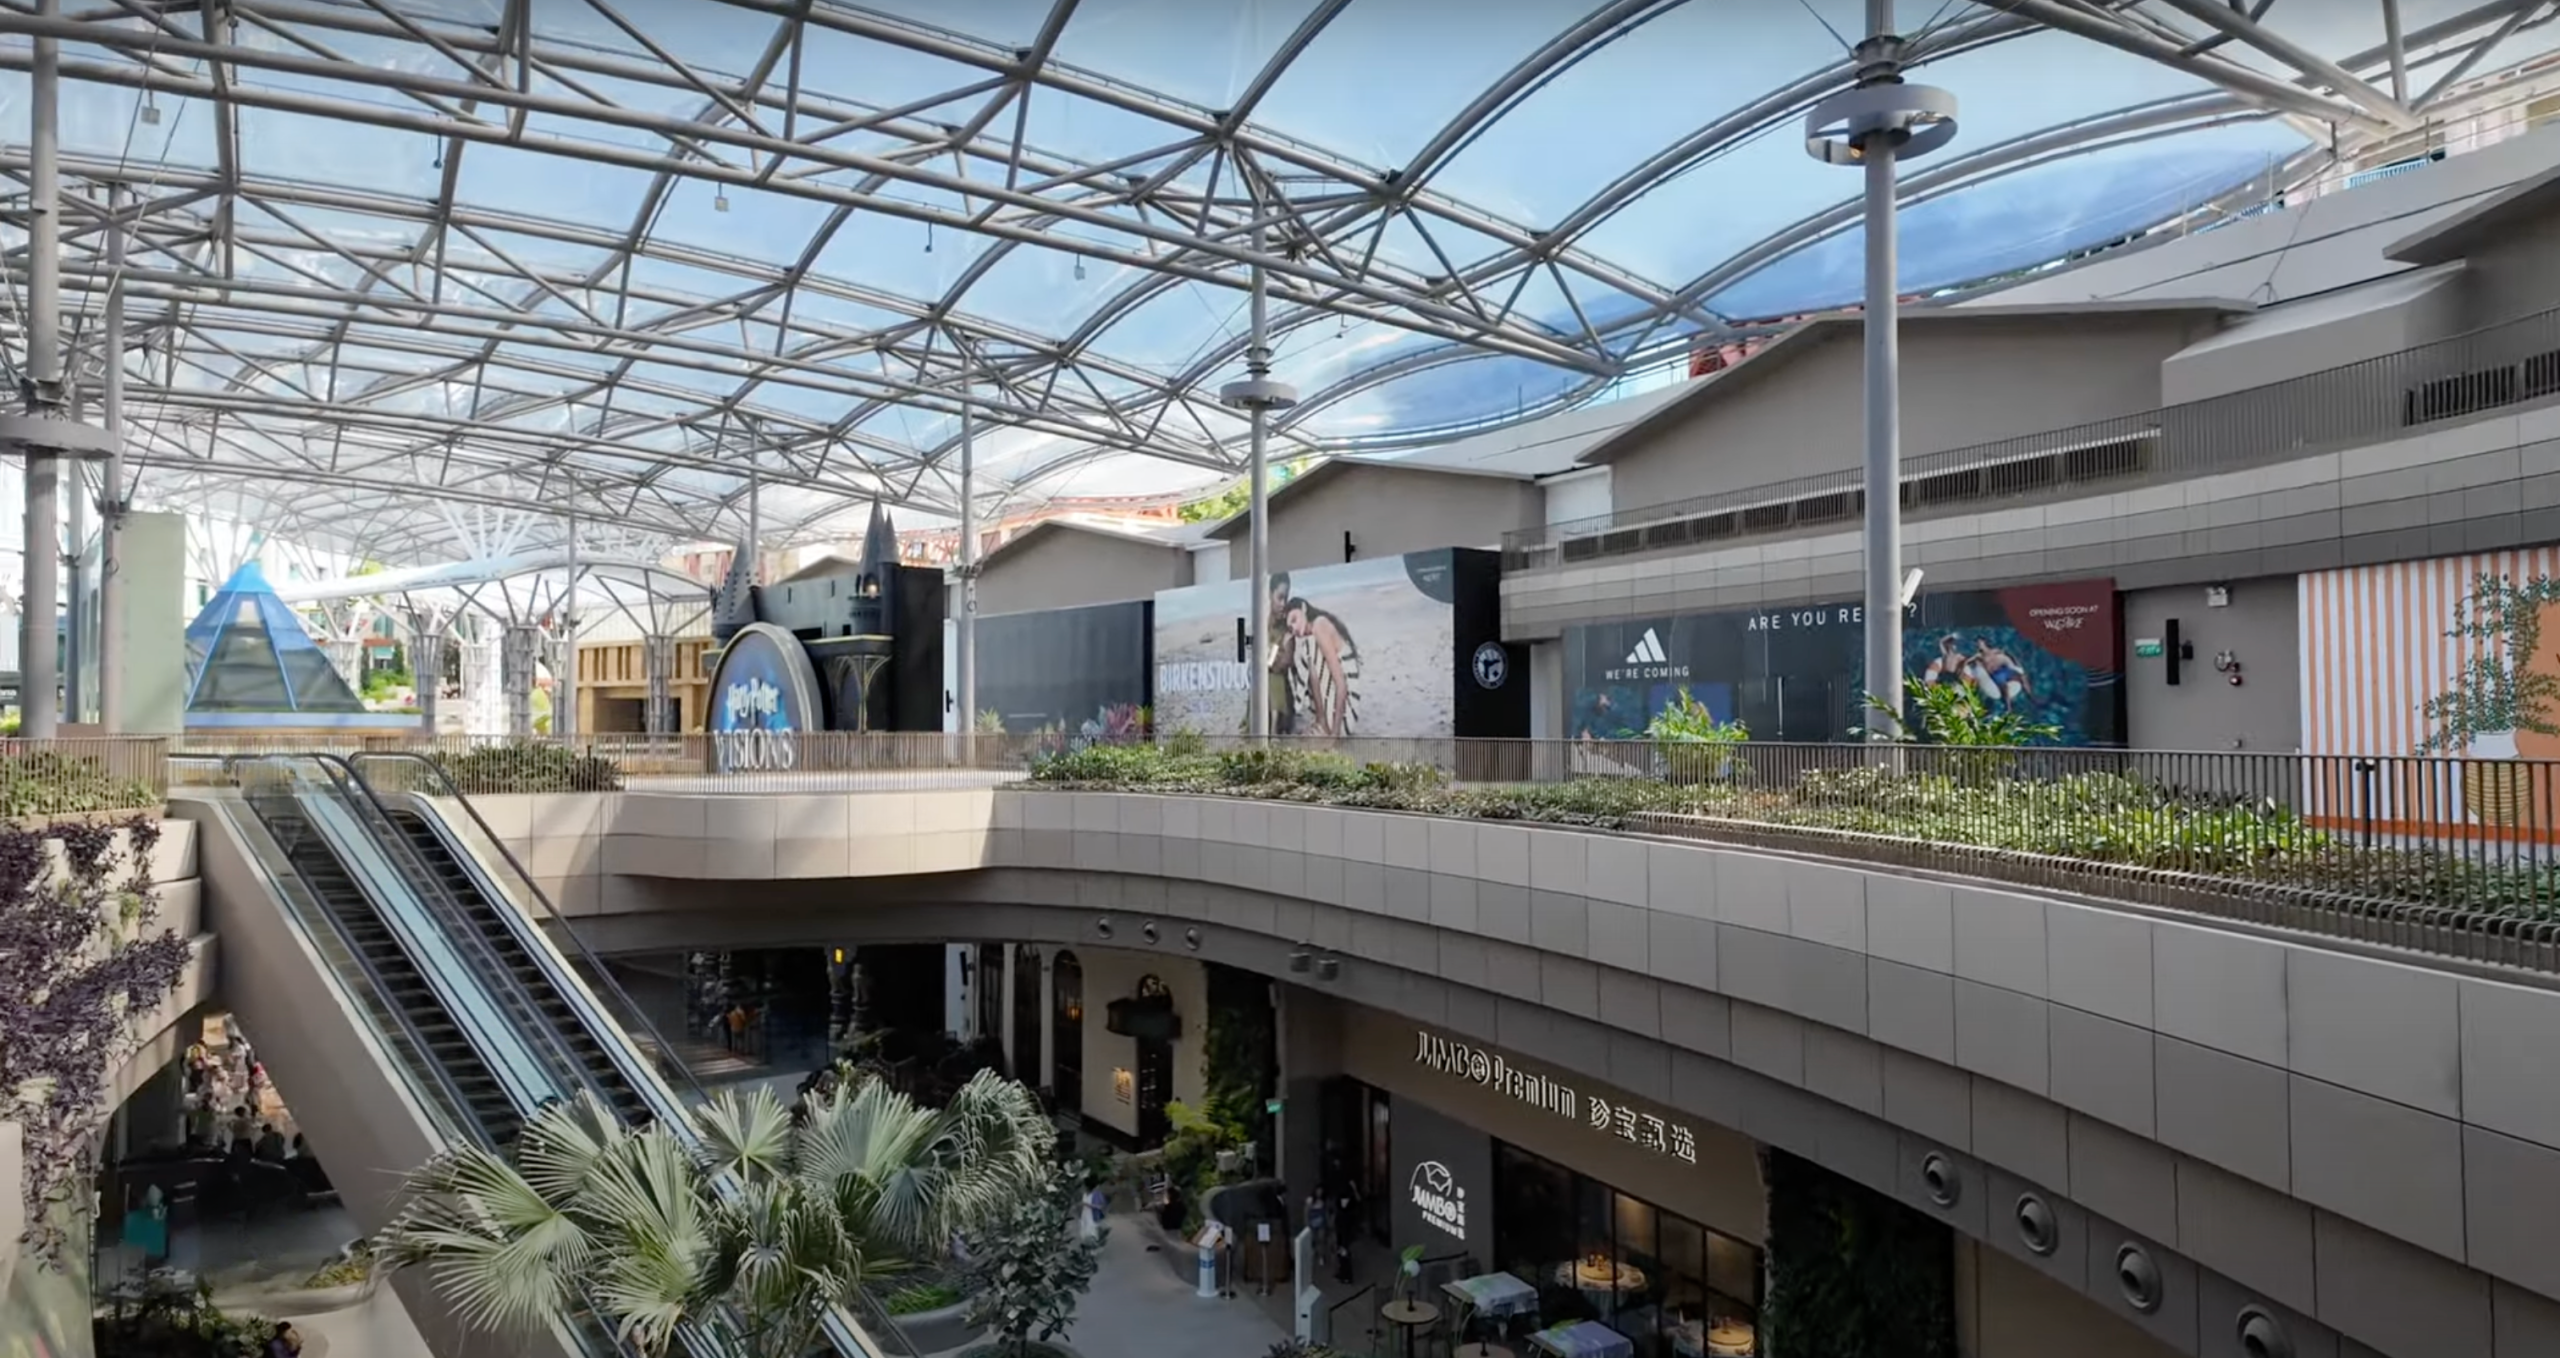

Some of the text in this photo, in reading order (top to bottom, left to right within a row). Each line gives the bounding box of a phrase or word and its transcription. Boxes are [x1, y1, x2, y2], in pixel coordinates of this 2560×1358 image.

[1748, 614, 1781, 631] ARE
[1791, 610, 1827, 627] YOU
[2064, 605, 2088, 616] SOON
[1159, 660, 1251, 693] BIRKENSTOCK
[1605, 665, 1690, 681] WE'RE COMING
[713, 727, 794, 770] VISIONS
[1415, 1030, 1697, 1164] JUMBO Premium 珍宝甄选
[1411, 1184, 1457, 1222] JUMBO
